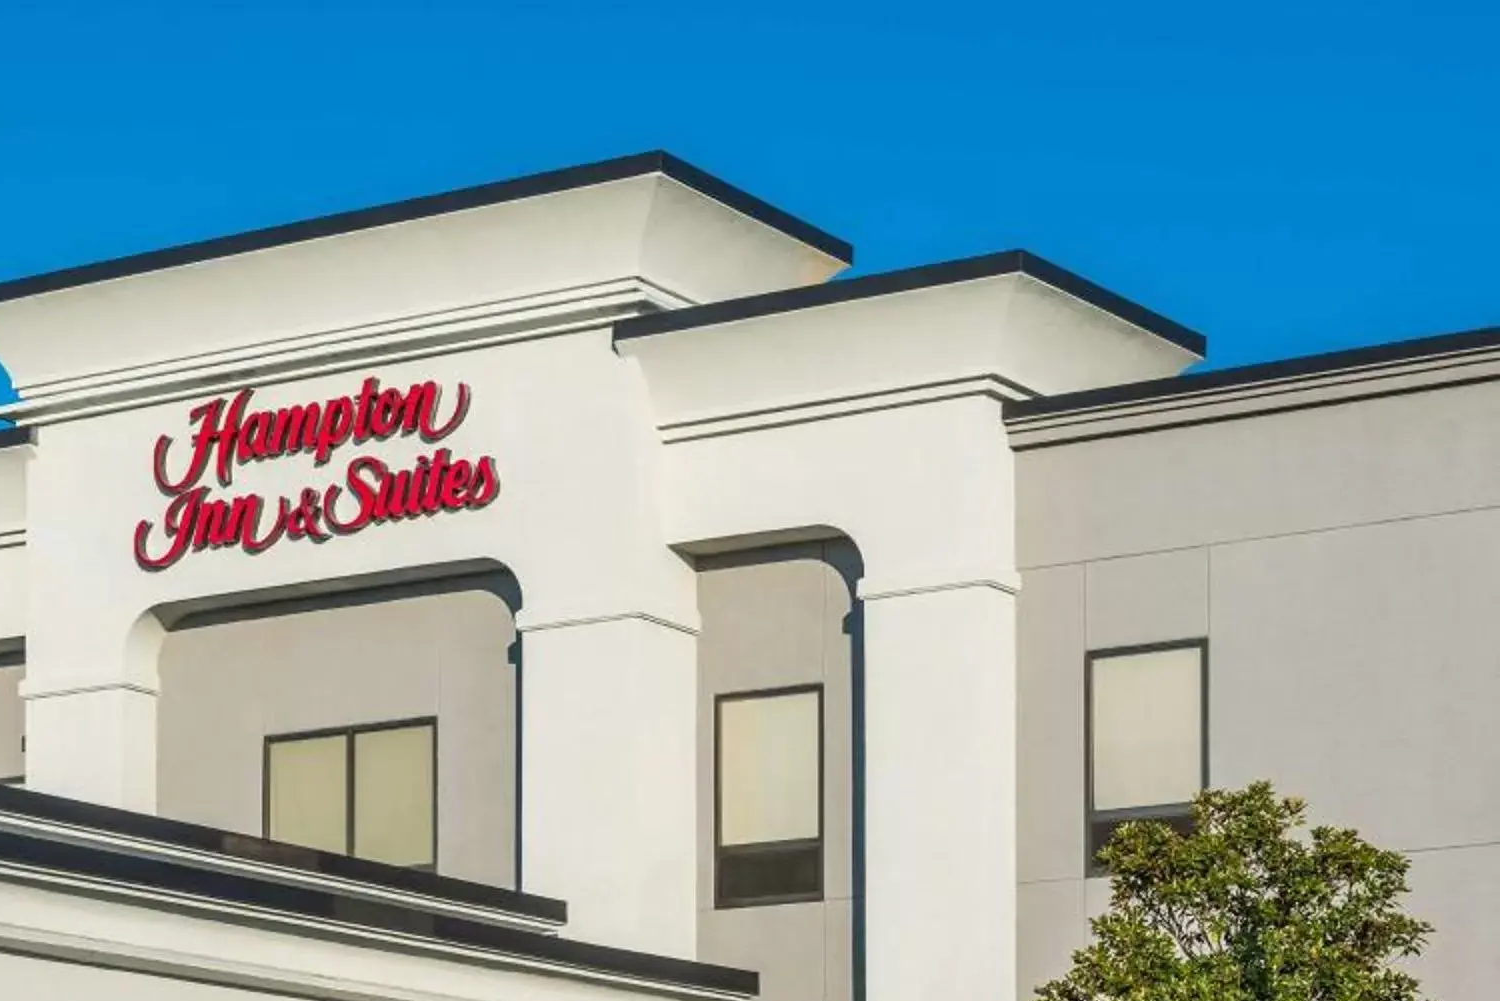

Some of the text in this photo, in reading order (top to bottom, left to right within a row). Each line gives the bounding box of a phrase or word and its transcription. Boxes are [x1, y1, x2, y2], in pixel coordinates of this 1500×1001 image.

[153, 377, 471, 497] Hampton
[133, 448, 501, 572] Inn & Suites
